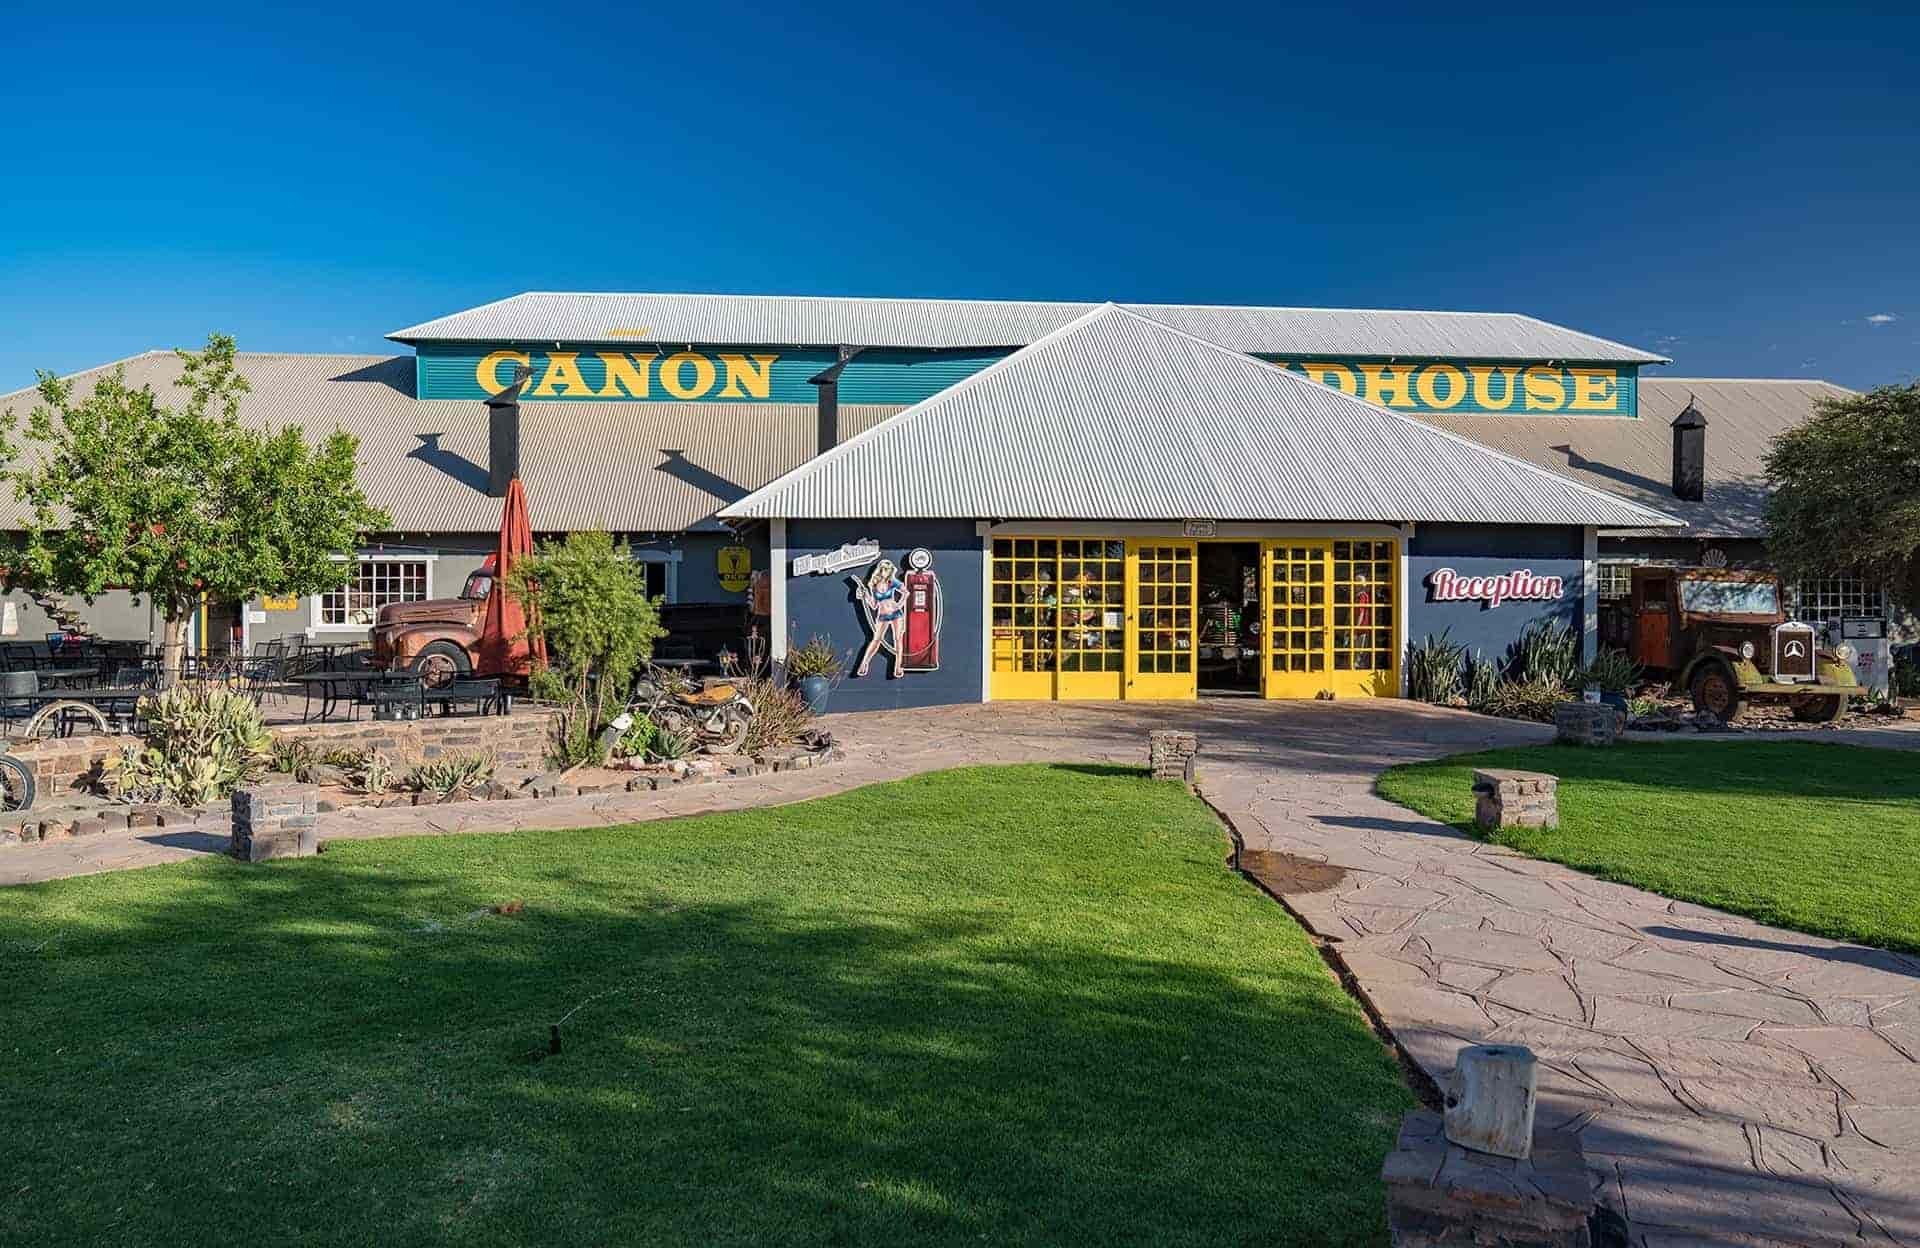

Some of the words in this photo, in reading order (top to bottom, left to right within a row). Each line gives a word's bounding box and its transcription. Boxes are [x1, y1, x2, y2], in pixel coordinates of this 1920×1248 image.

[476, 351, 780, 399] CANON
[1275, 362, 1618, 412] DHOUSE
[1432, 568, 1563, 608] Reception
